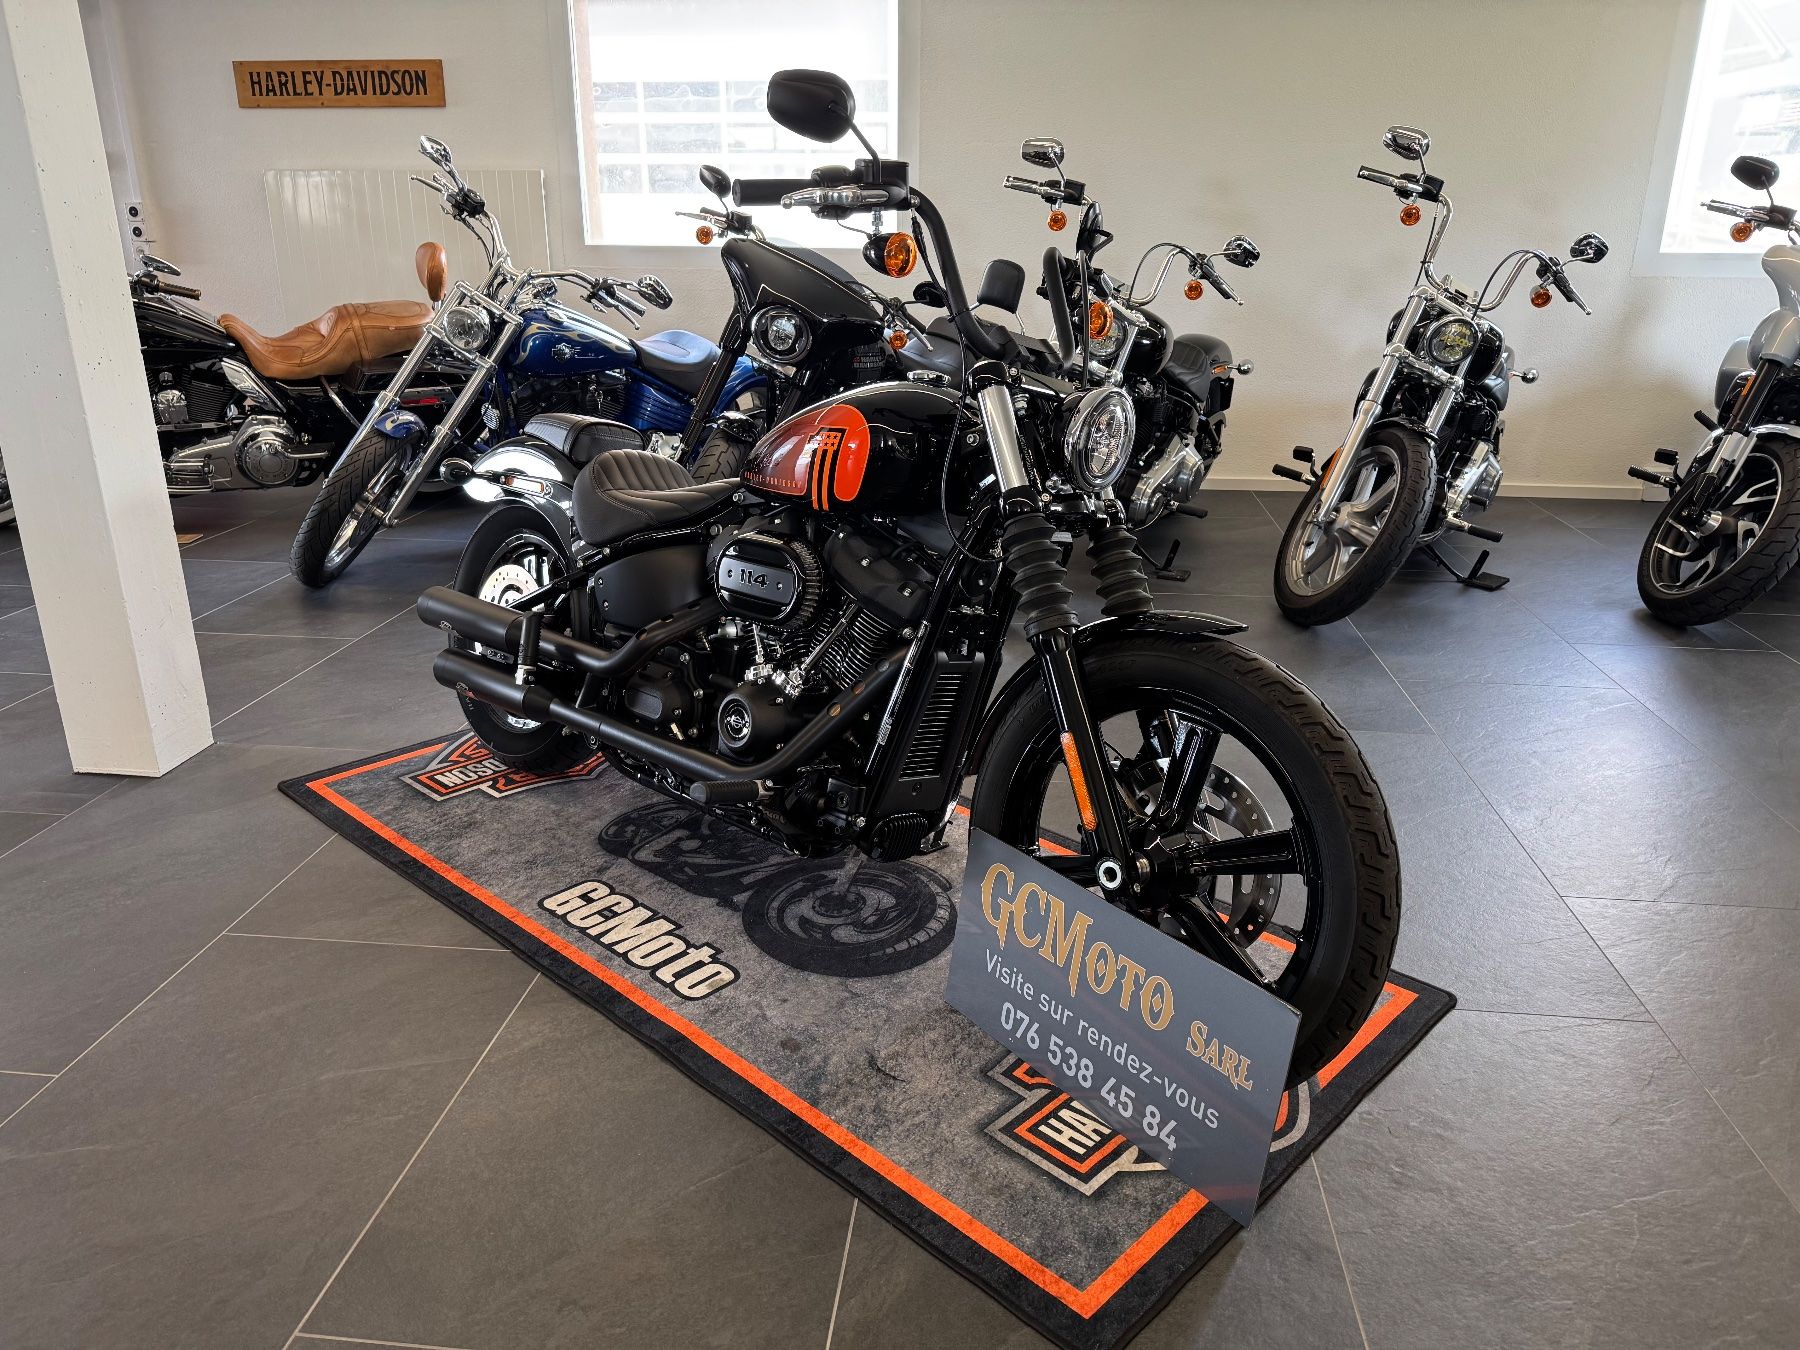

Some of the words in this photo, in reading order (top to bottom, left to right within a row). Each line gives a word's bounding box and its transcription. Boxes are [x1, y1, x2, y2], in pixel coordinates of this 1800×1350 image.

[249, 69, 429, 97] HARLEY-DAVIDSON
[740, 568, 769, 588] 114
[541, 880, 738, 999] GCMoto
[985, 949, 1034, 1001] Visite
[1038, 993, 1073, 1026] sur
[1077, 1018, 1220, 1129] rendez-vous
[1000, 1001, 1040, 1050] 076
[1047, 1033, 1094, 1089] 538
[1100, 1076, 1136, 1118] 45
[1142, 1104, 1178, 1152] 84
